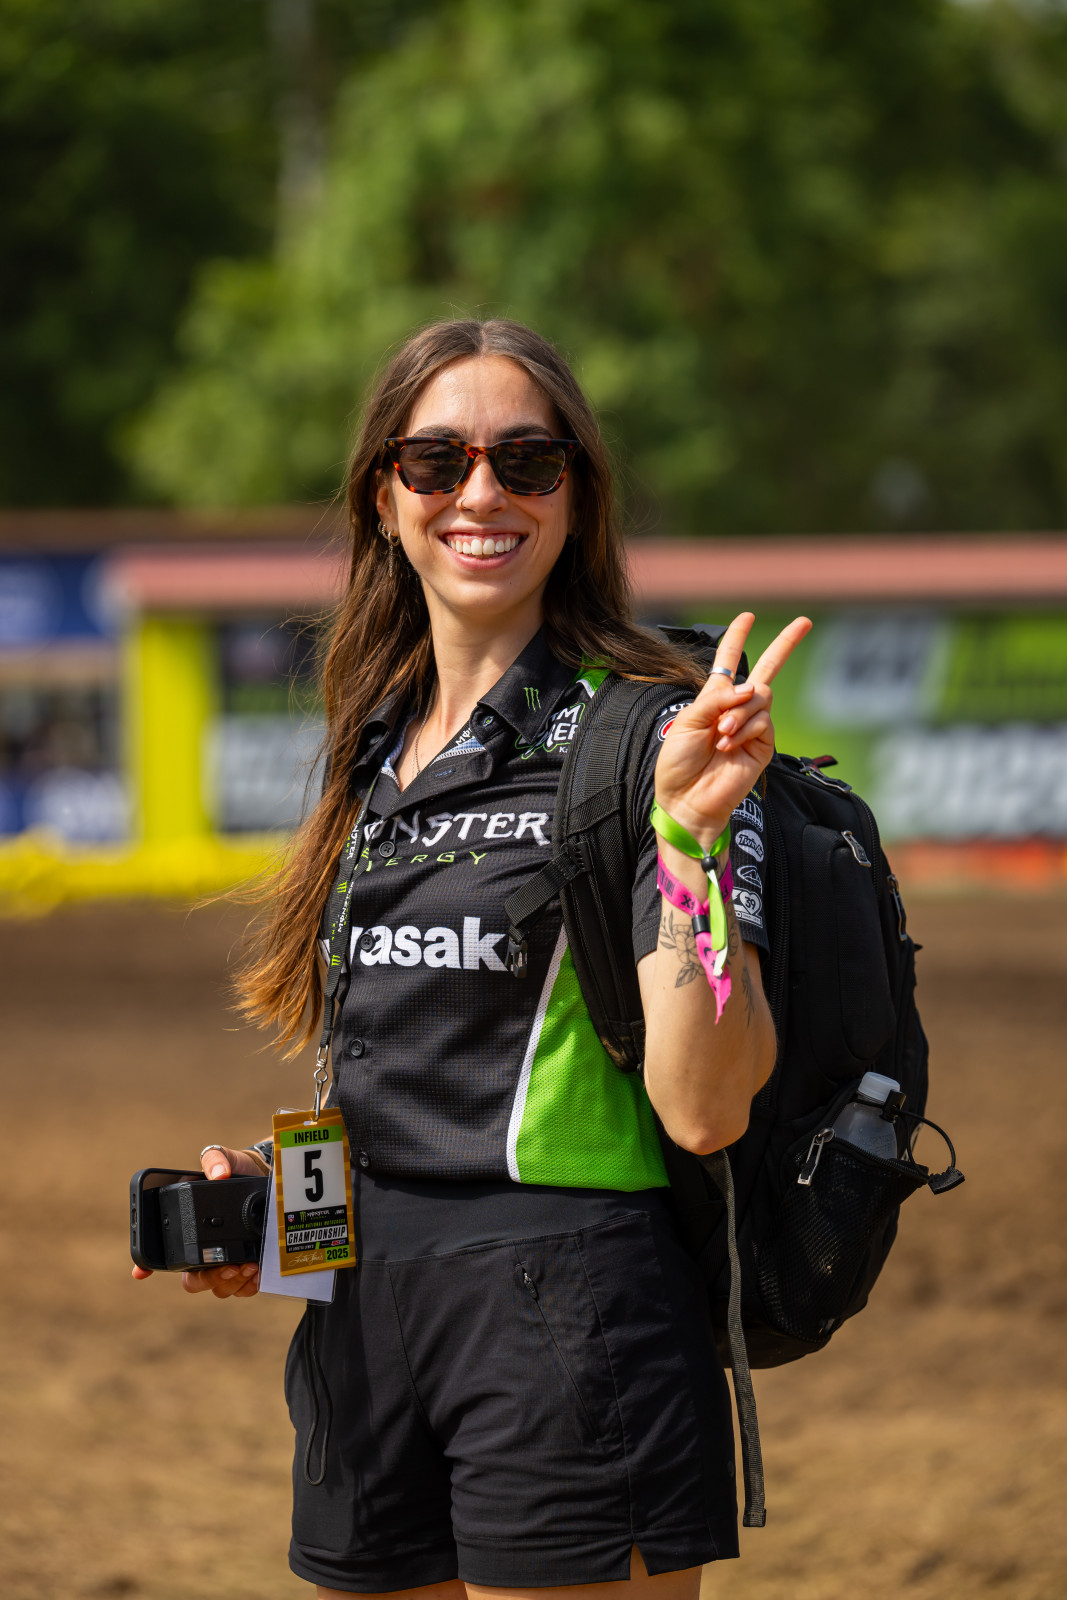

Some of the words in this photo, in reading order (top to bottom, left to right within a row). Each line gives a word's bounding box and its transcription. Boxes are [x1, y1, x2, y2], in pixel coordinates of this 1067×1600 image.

[364, 810, 550, 847] NSTER
[294, 1129, 329, 1144] INFIELD
[304, 1150, 324, 1203] 5
[288, 1226, 346, 1244] CHAMPIONSHIP
[326, 1248, 349, 1261] 2025
